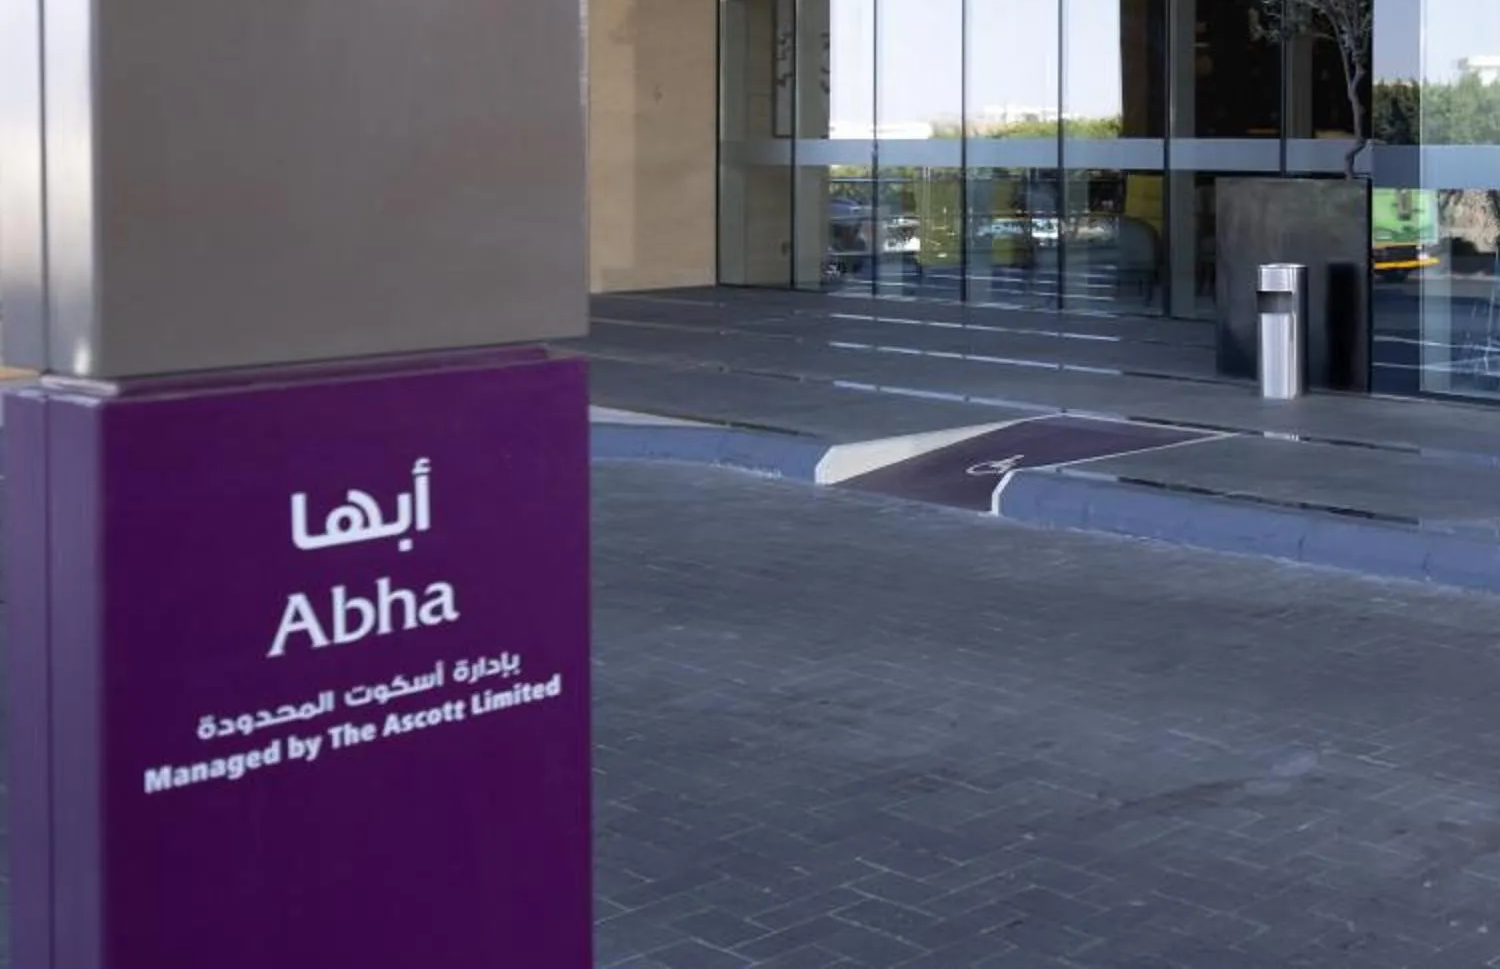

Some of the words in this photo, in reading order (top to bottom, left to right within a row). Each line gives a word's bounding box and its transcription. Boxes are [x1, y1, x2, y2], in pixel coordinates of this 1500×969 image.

[291, 457, 431, 552] أبها
[266, 577, 460, 657] Abha
[344, 661, 444, 707] أسكوت
[452, 652, 520, 683] بإدارة
[144, 740, 281, 793] Managed
[287, 735, 322, 761] by
[327, 722, 377, 749] The
[382, 700, 466, 737] Ascott
[471, 673, 562, 715] Limited
[197, 690, 334, 740] المحدودة
